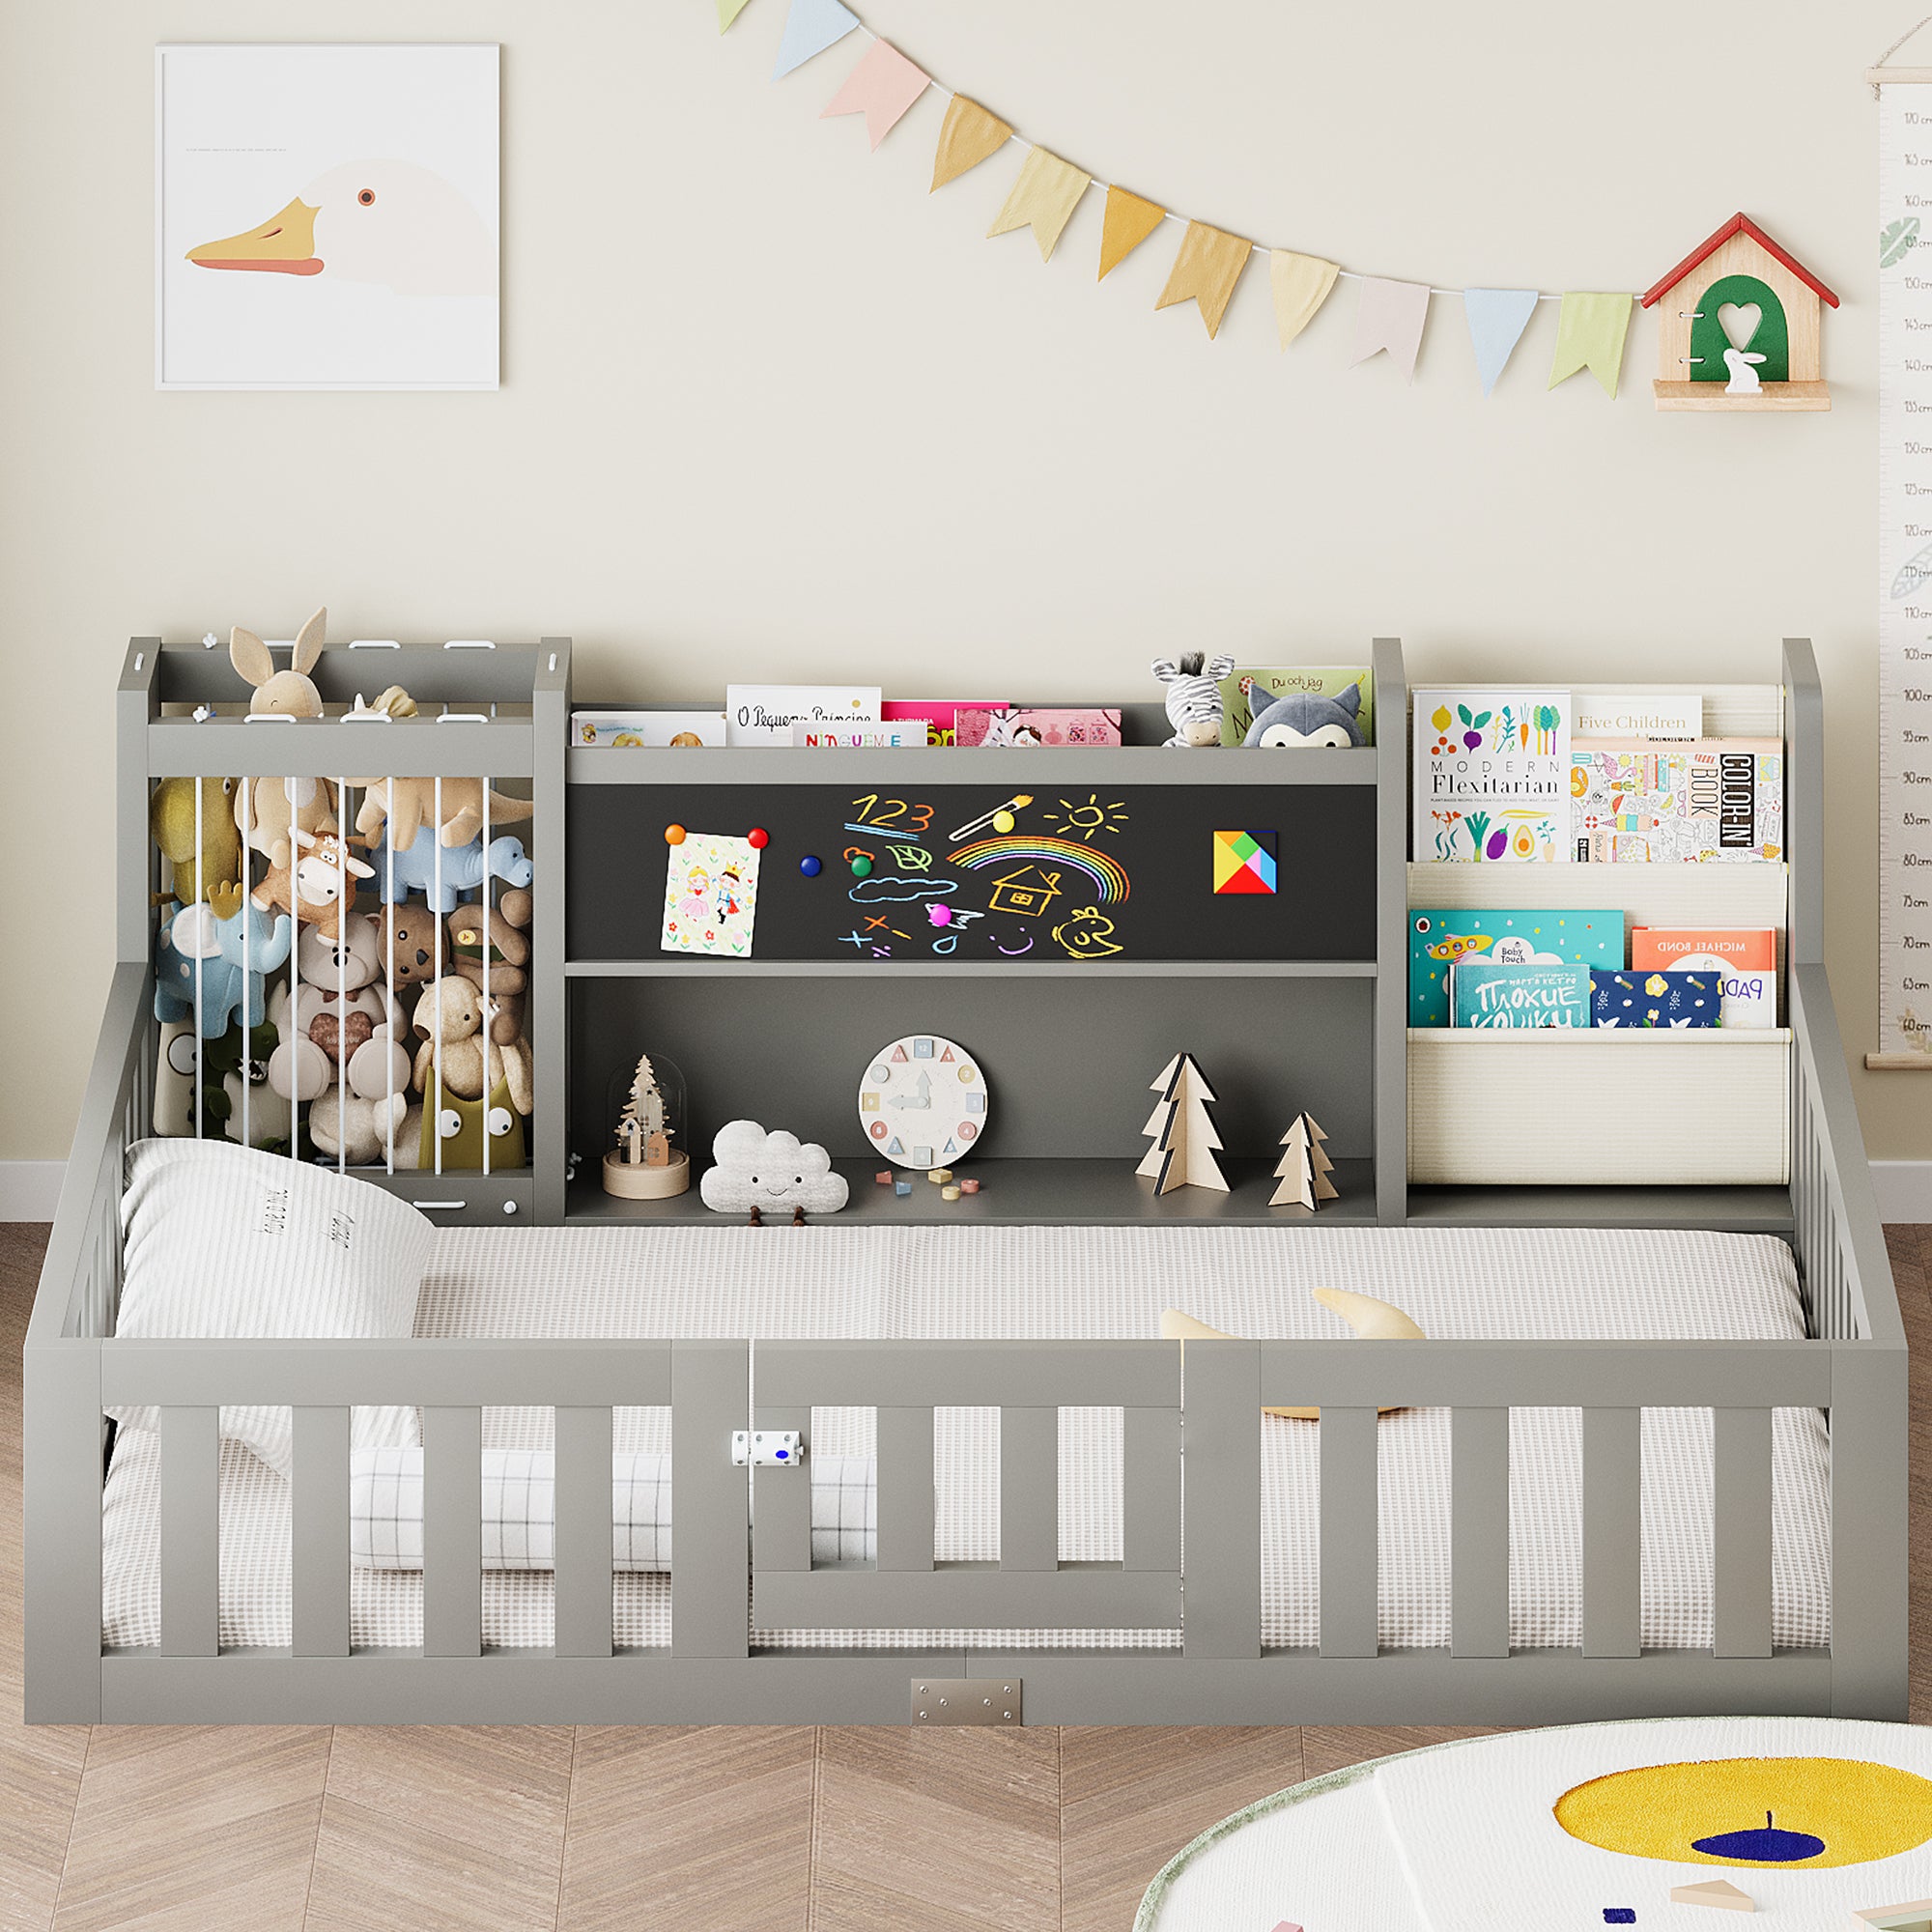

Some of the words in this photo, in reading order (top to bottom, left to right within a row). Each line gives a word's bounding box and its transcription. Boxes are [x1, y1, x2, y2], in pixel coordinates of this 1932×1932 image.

[1271, 677, 1285, 690] Du
[1288, 675, 1305, 686] och
[1302, 676, 1322, 692] jag
[738, 706, 750, 726] O
[1578, 716, 1611, 728] Five
[1615, 715, 1686, 728] Children
[1431, 760, 1560, 773] MODERN
[1433, 774, 1558, 793] Flexitarian
[1690, 768, 1719, 816] BOOK
[1500, 955, 1525, 964] Touch
